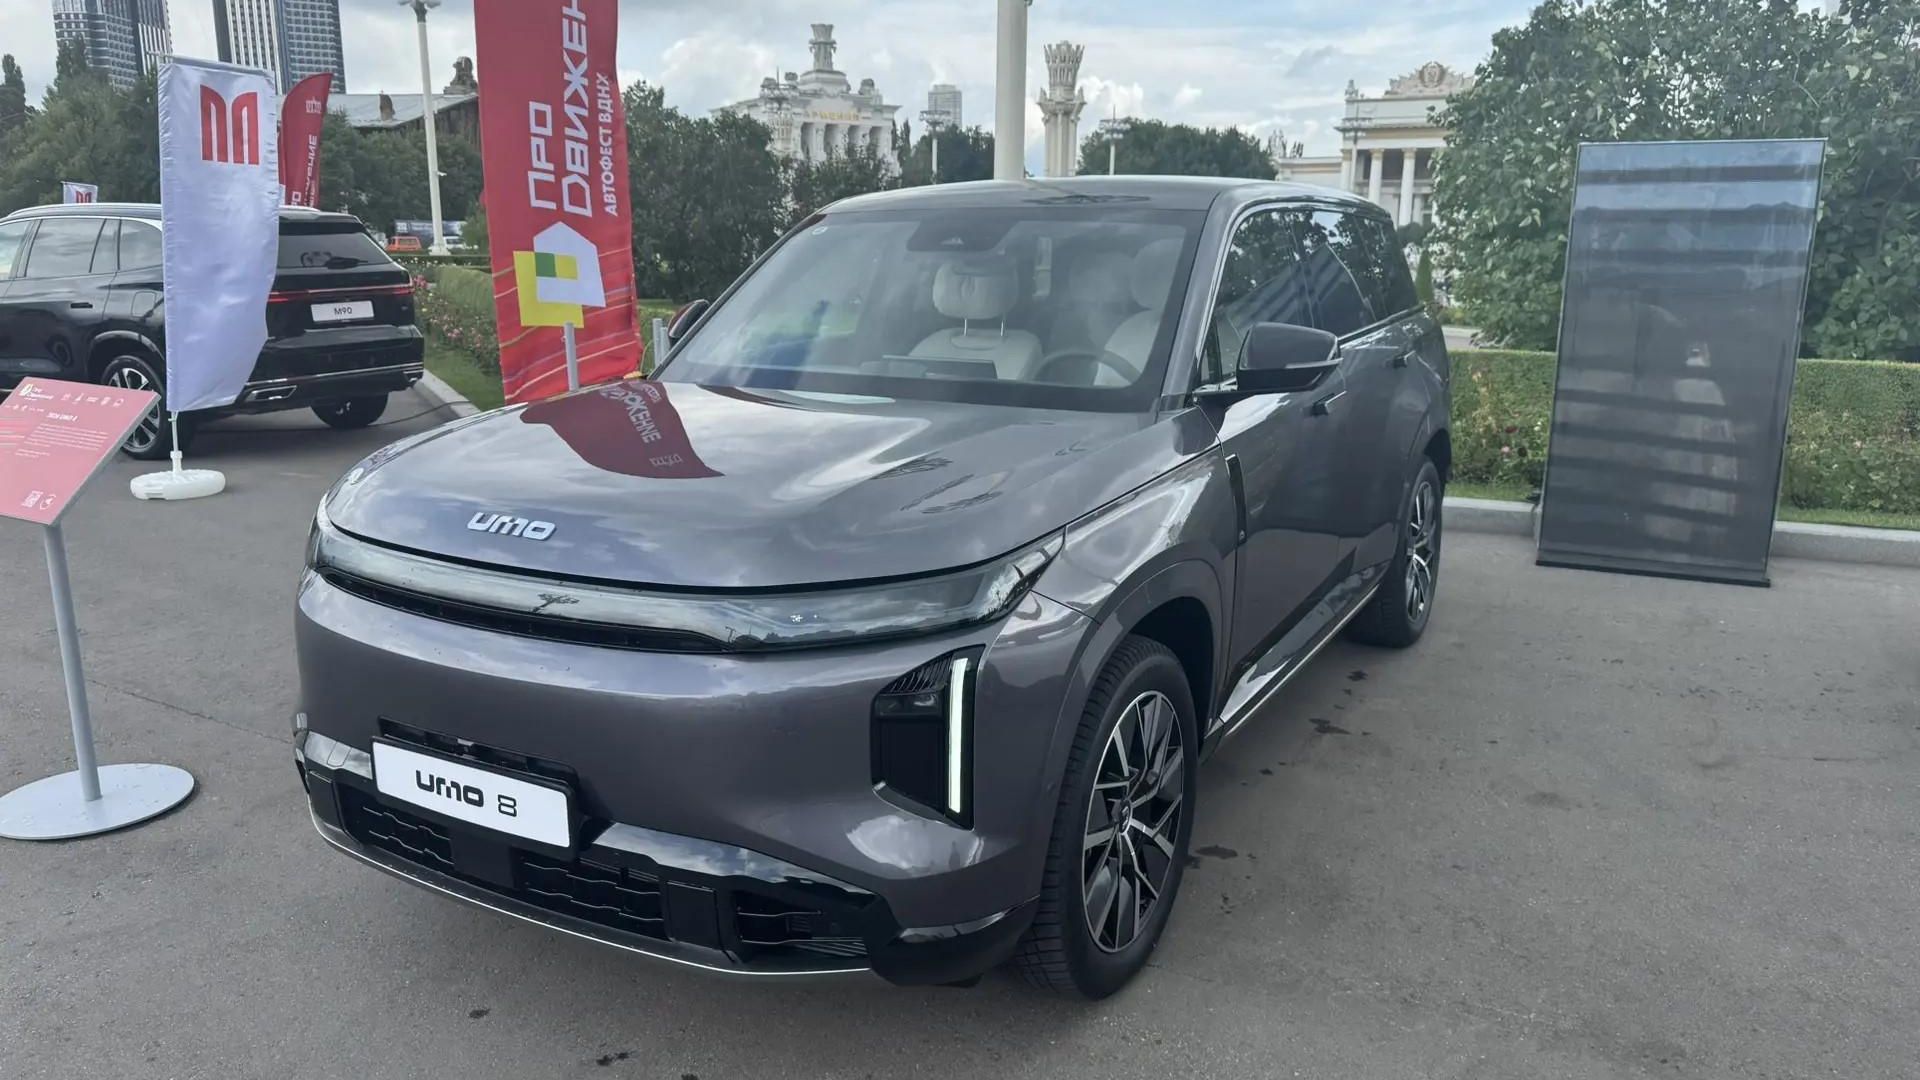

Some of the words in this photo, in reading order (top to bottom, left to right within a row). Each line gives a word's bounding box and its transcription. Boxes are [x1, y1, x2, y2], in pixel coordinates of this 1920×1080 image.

[596, 72, 614, 122] ВДНХ
[528, 101, 557, 210] ПРО
[599, 127, 618, 217] АВТОФЕСТ
[334, 306, 353, 316] M90
[498, 794, 517, 817] 8
